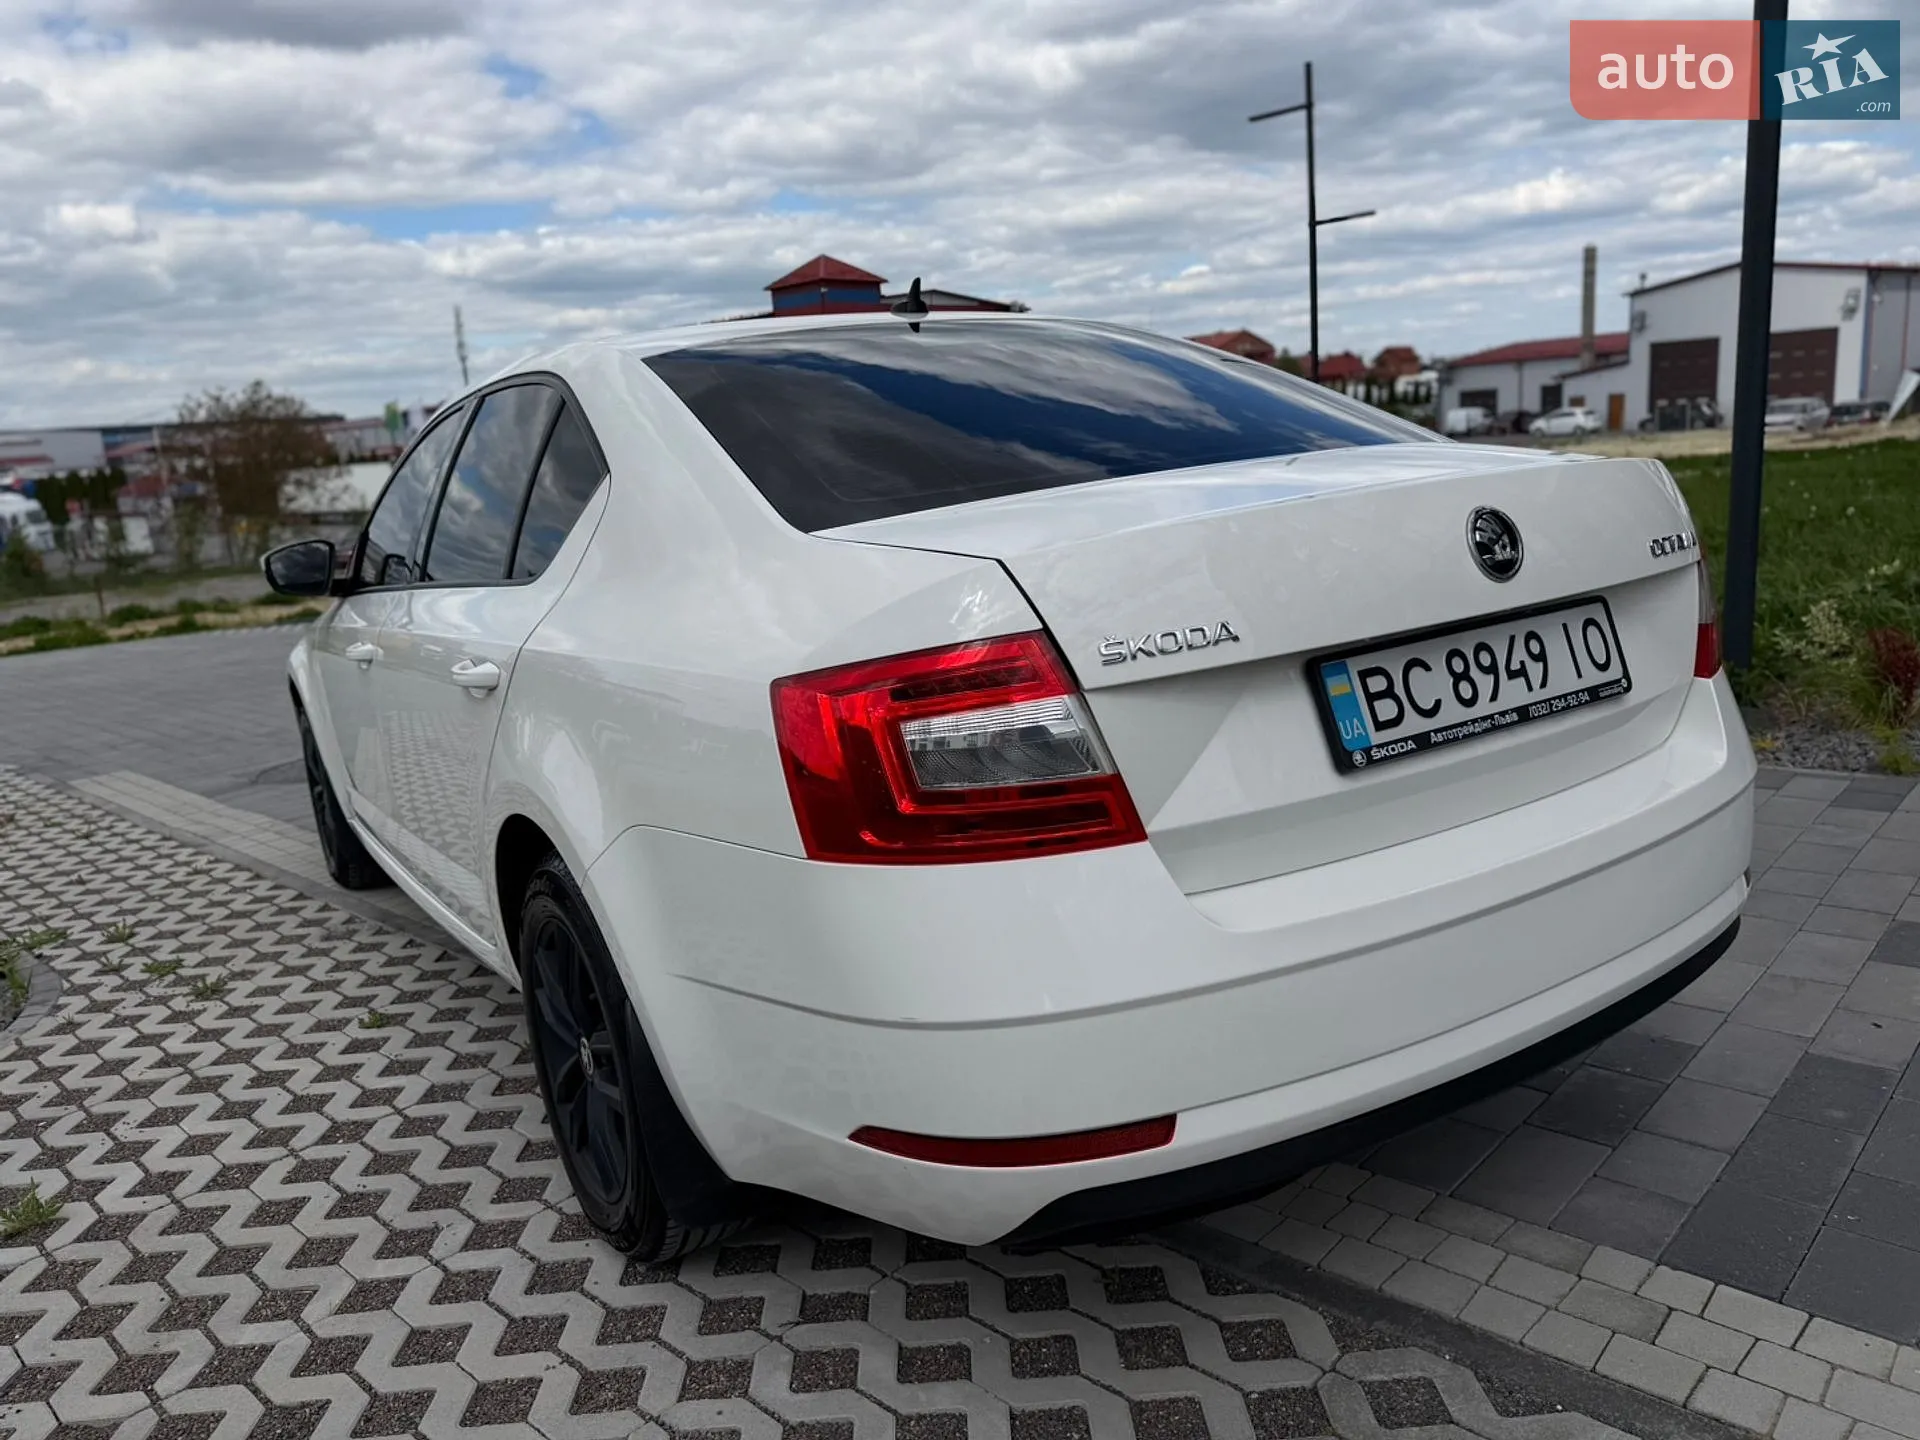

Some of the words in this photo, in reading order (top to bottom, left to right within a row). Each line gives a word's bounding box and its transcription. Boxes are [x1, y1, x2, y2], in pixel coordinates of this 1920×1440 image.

[1098, 620, 1240, 666] ŠKODA
[1445, 630, 1549, 708] 8949
[1551, 690, 1590, 711] 294-92-94
[1339, 717, 1366, 740] UA
[1430, 710, 1519, 744] Автотрейдінг-Львів
[1370, 740, 1417, 760] ŠKODA
